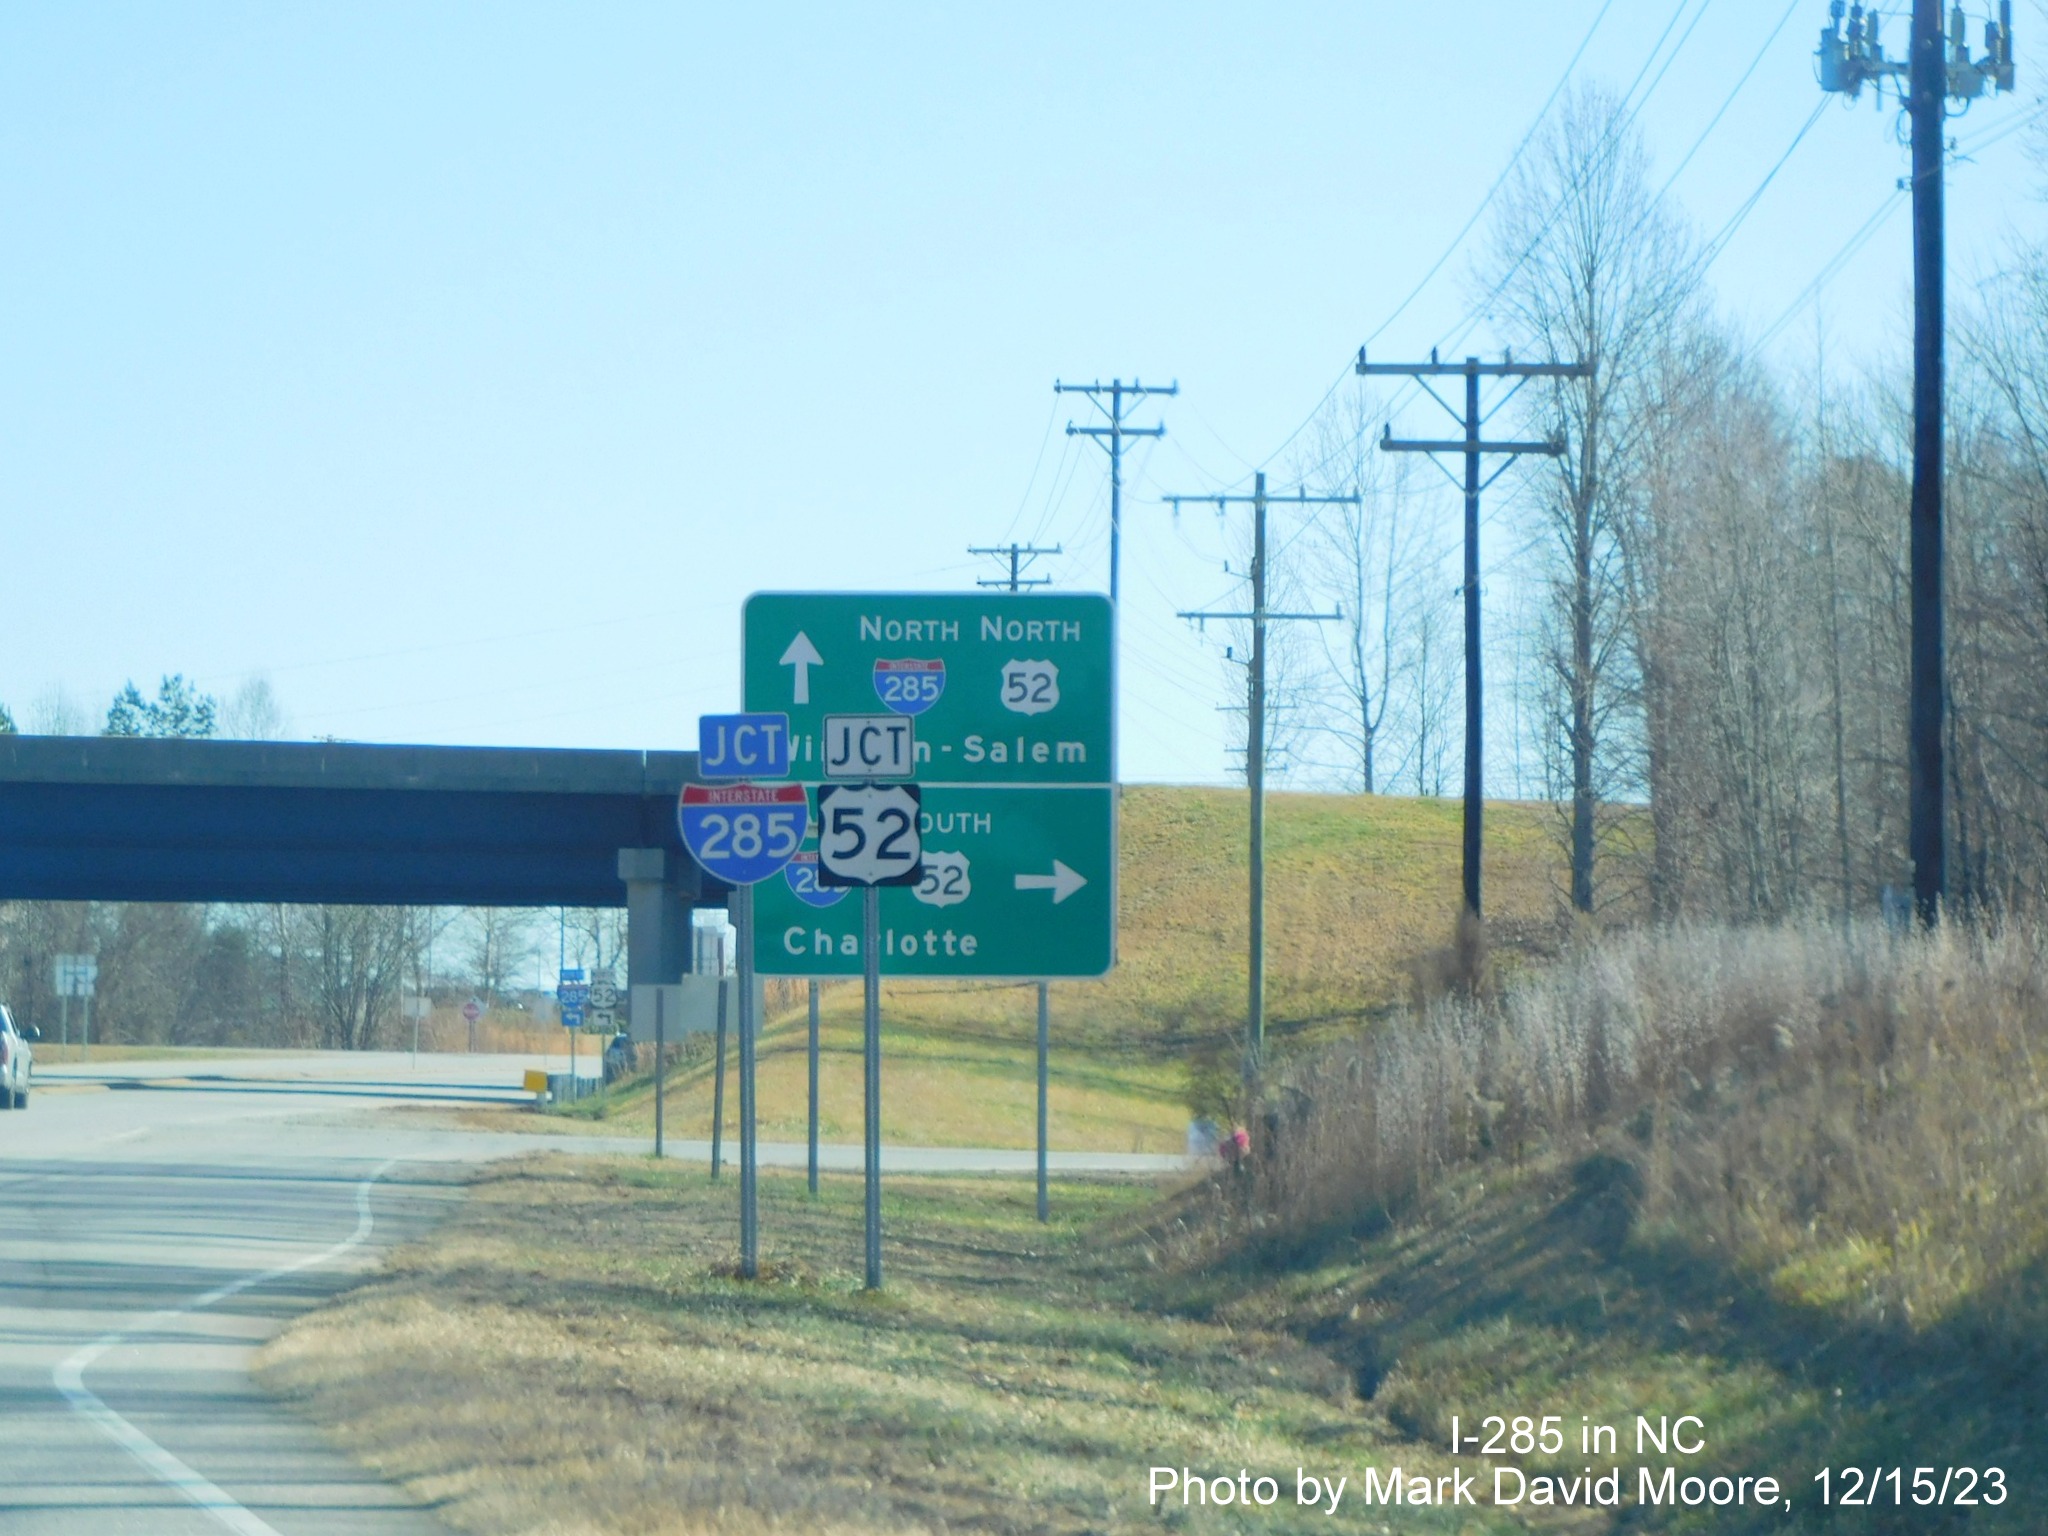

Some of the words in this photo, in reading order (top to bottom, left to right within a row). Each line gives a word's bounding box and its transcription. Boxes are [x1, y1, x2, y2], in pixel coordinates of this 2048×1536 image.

[860, 615, 959, 642] NORTH
[981, 615, 1081, 642] NORTH
[884, 675, 939, 702] 285
[1008, 672, 1053, 704] 52
[705, 724, 782, 767] JCT
[831, 725, 906, 766] JCT
[708, 789, 779, 803] INTERSTATE
[699, 812, 798, 859] 285
[831, 807, 912, 860] 52
[921, 812, 992, 834] OUTH
[920, 865, 963, 895] 52
[783, 926, 979, 957] Chalotte
[562, 989, 587, 1004] 285
[593, 988, 615, 1003] 52
